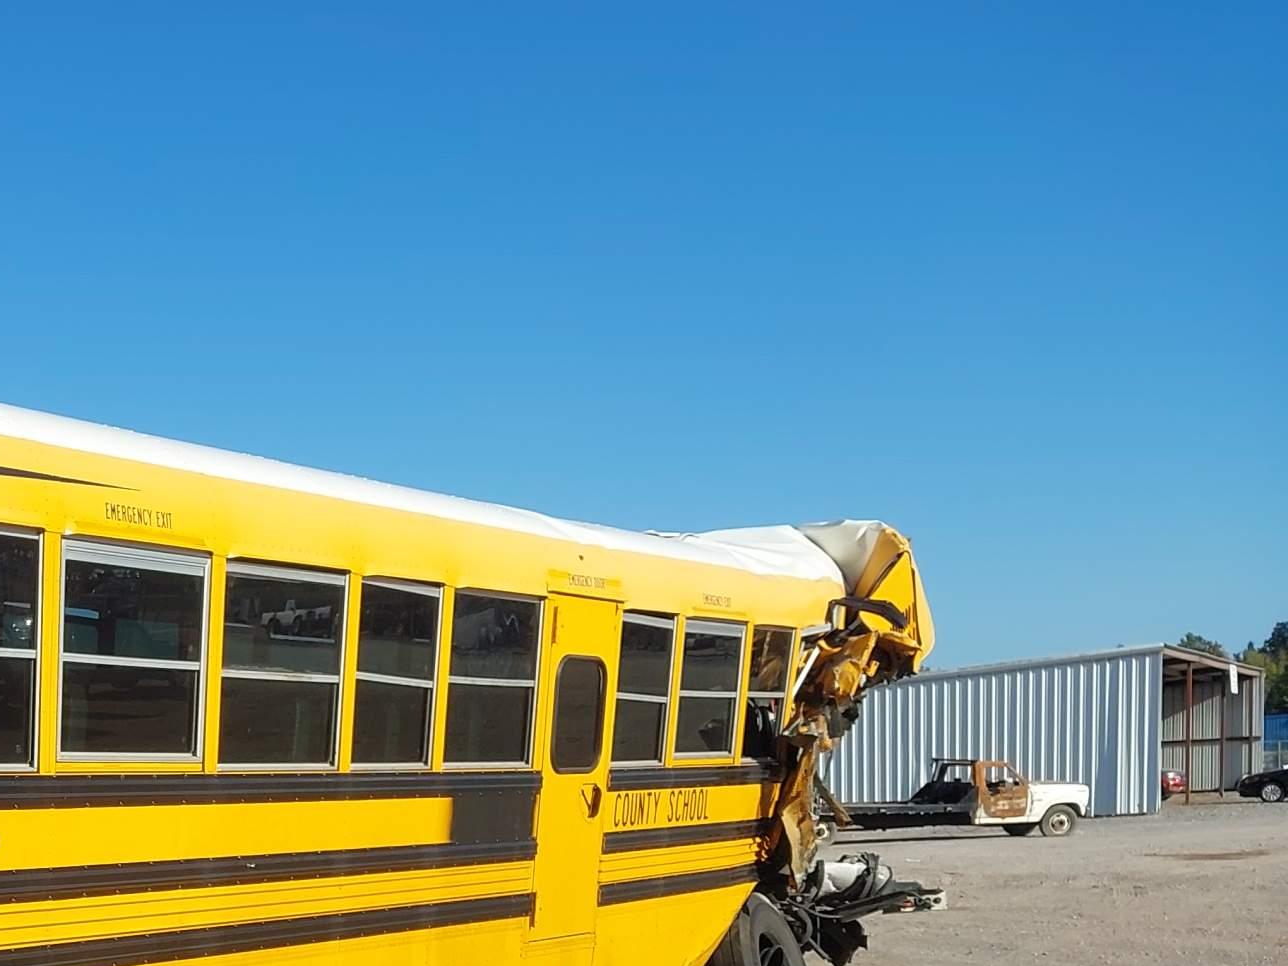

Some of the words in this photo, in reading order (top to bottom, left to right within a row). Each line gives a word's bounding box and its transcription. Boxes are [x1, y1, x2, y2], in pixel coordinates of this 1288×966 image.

[105, 502, 153, 526] EMERGENCY
[156, 511, 173, 529] EXIT
[613, 791, 661, 827] COUNTY
[667, 789, 709, 822] SCHOOL
